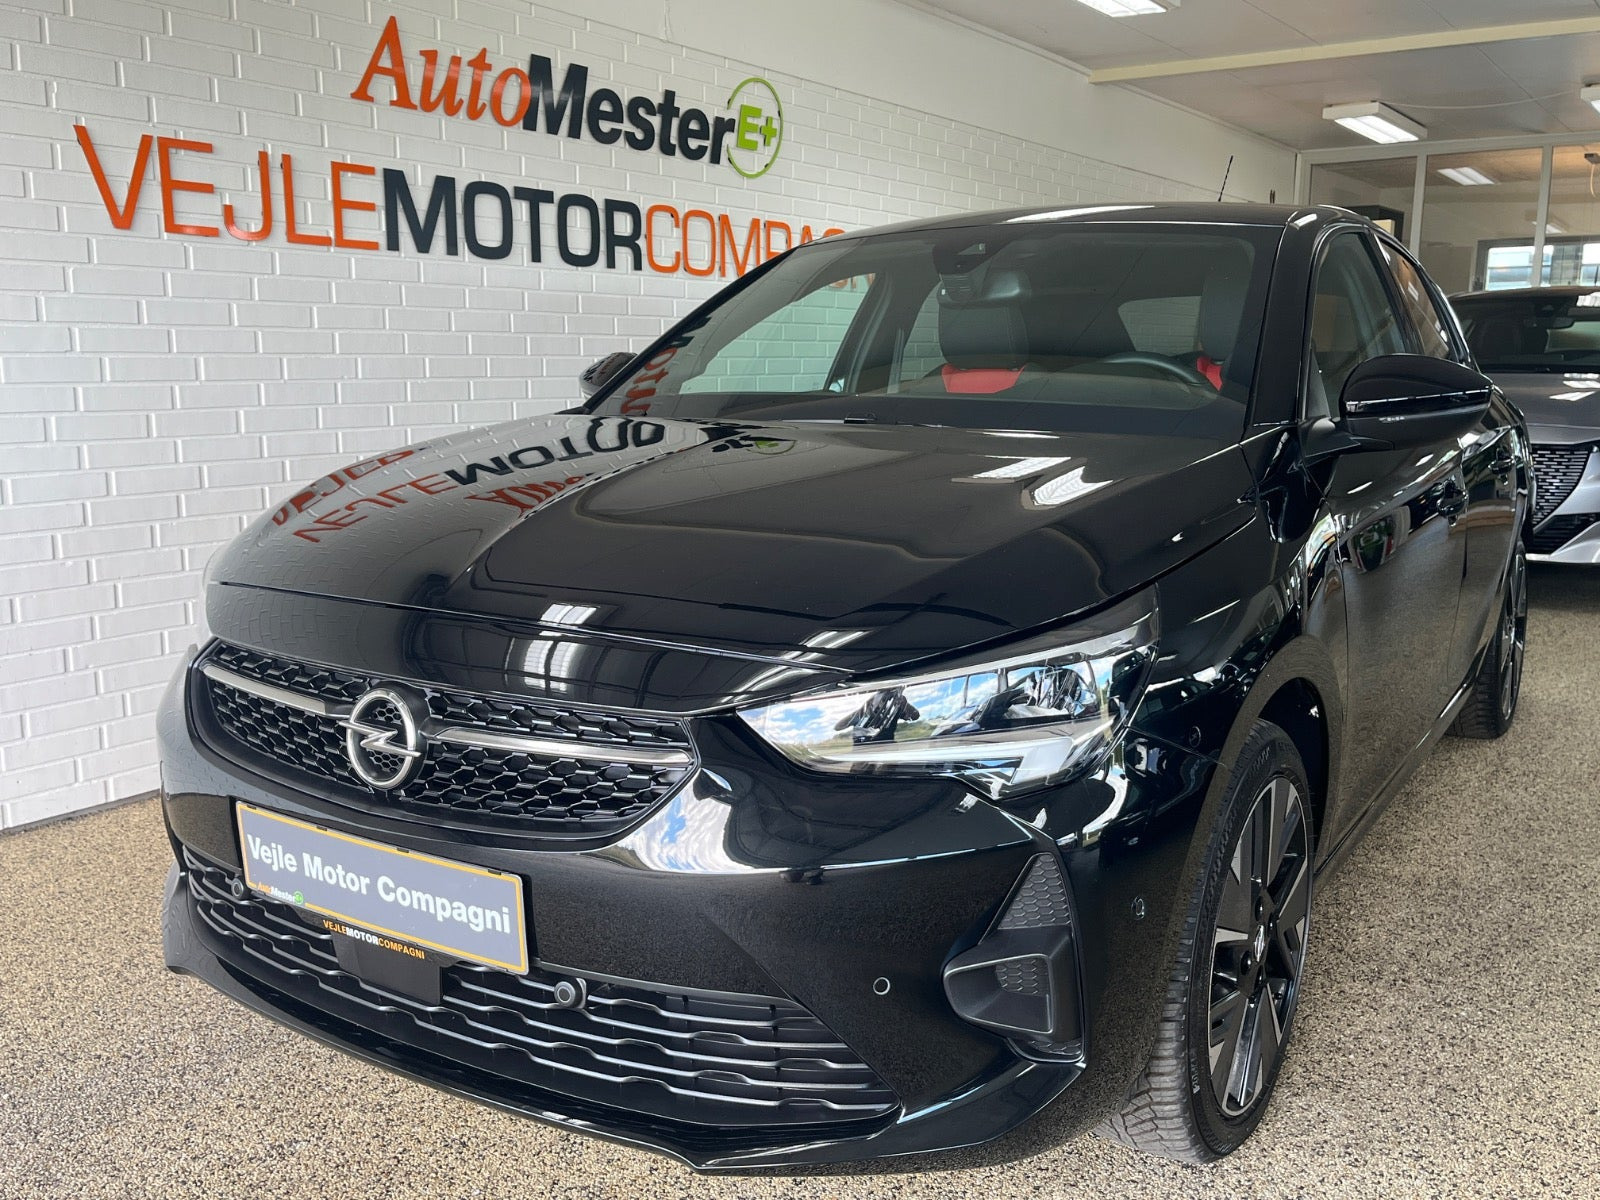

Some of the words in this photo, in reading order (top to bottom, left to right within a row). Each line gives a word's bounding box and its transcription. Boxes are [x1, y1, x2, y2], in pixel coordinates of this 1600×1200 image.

[350, 15, 735, 164] AutoMester
[73, 124, 847, 279] VEJLEMOTORCOMP
[247, 834, 297, 872] Vejle
[302, 852, 370, 895] Motor
[377, 876, 511, 934] Compagni
[323, 920, 425, 960] VEJLEMOTORCOMPAGNI
